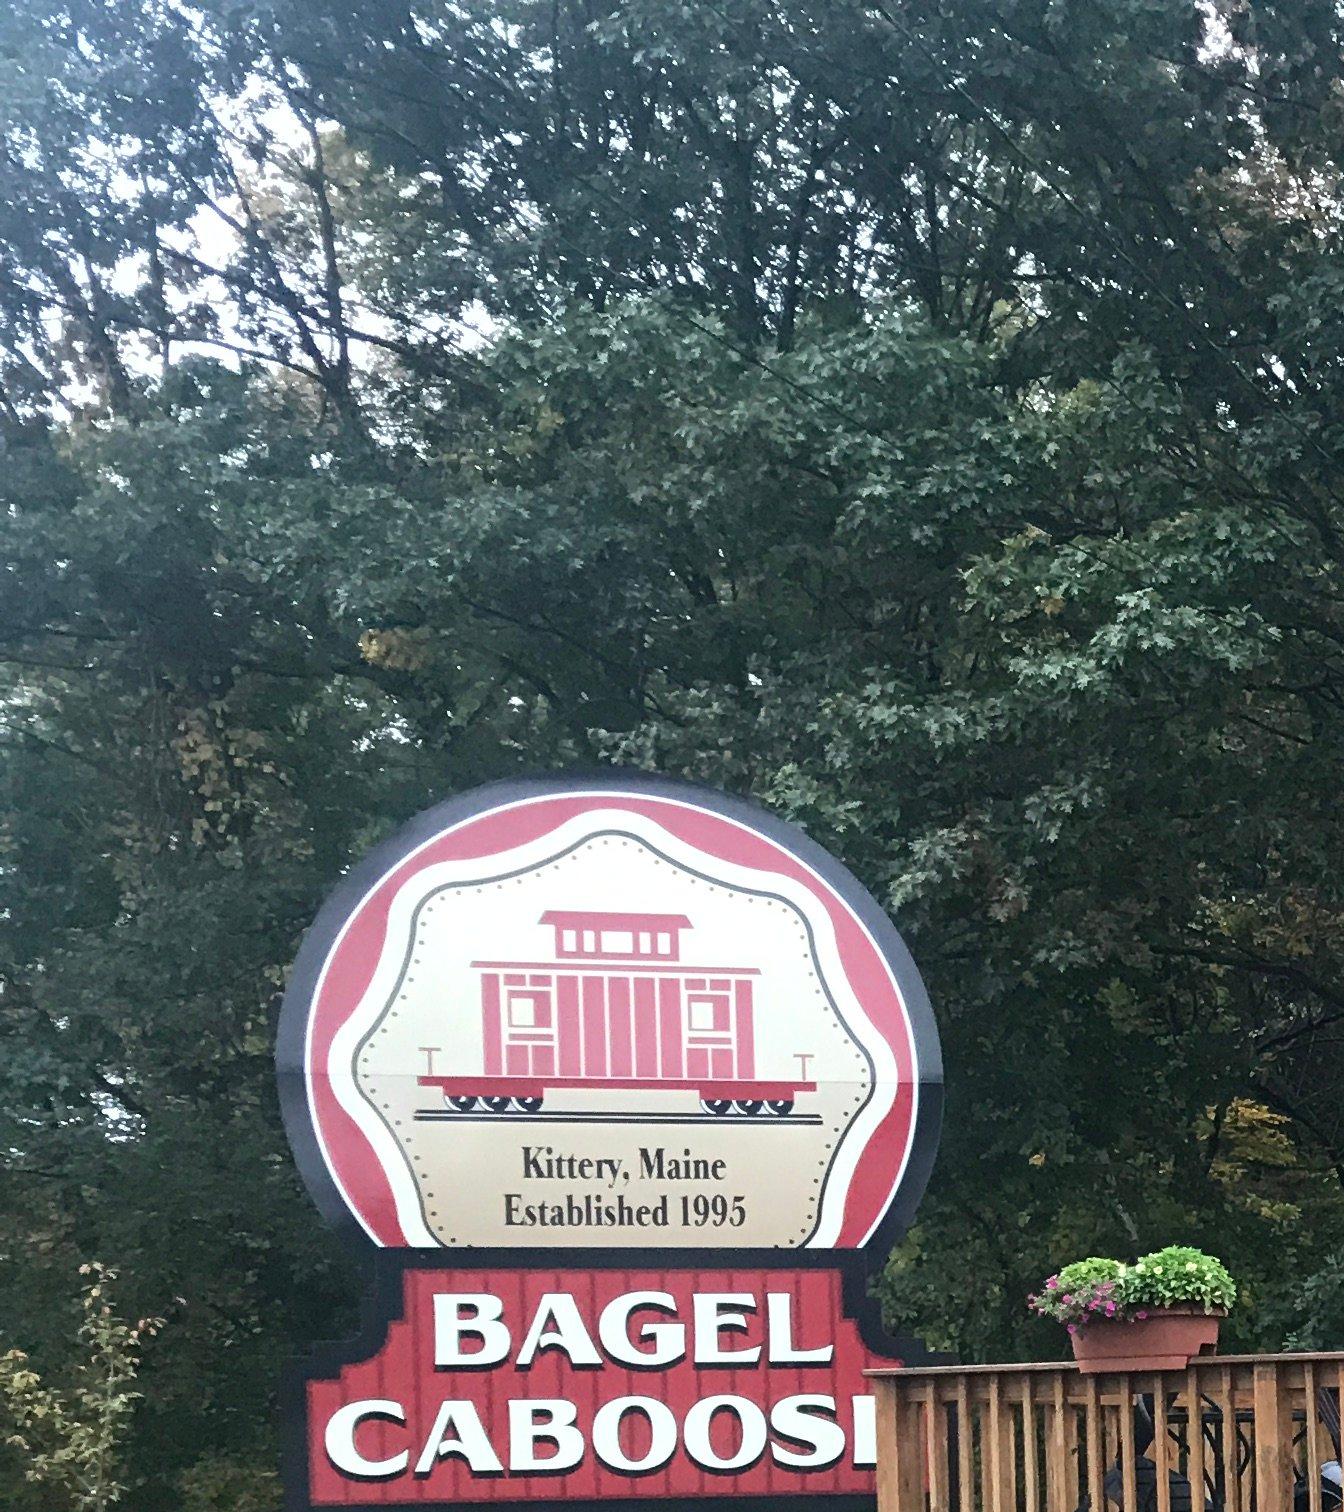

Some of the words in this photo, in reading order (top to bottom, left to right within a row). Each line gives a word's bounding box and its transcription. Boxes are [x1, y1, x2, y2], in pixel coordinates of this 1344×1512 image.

[521, 1146, 630, 1188] Kittery,
[638, 1147, 727, 1181] Maine
[503, 1193, 669, 1227] Established
[680, 1193, 746, 1227] 1995
[431, 1290, 834, 1368] BAGEL
